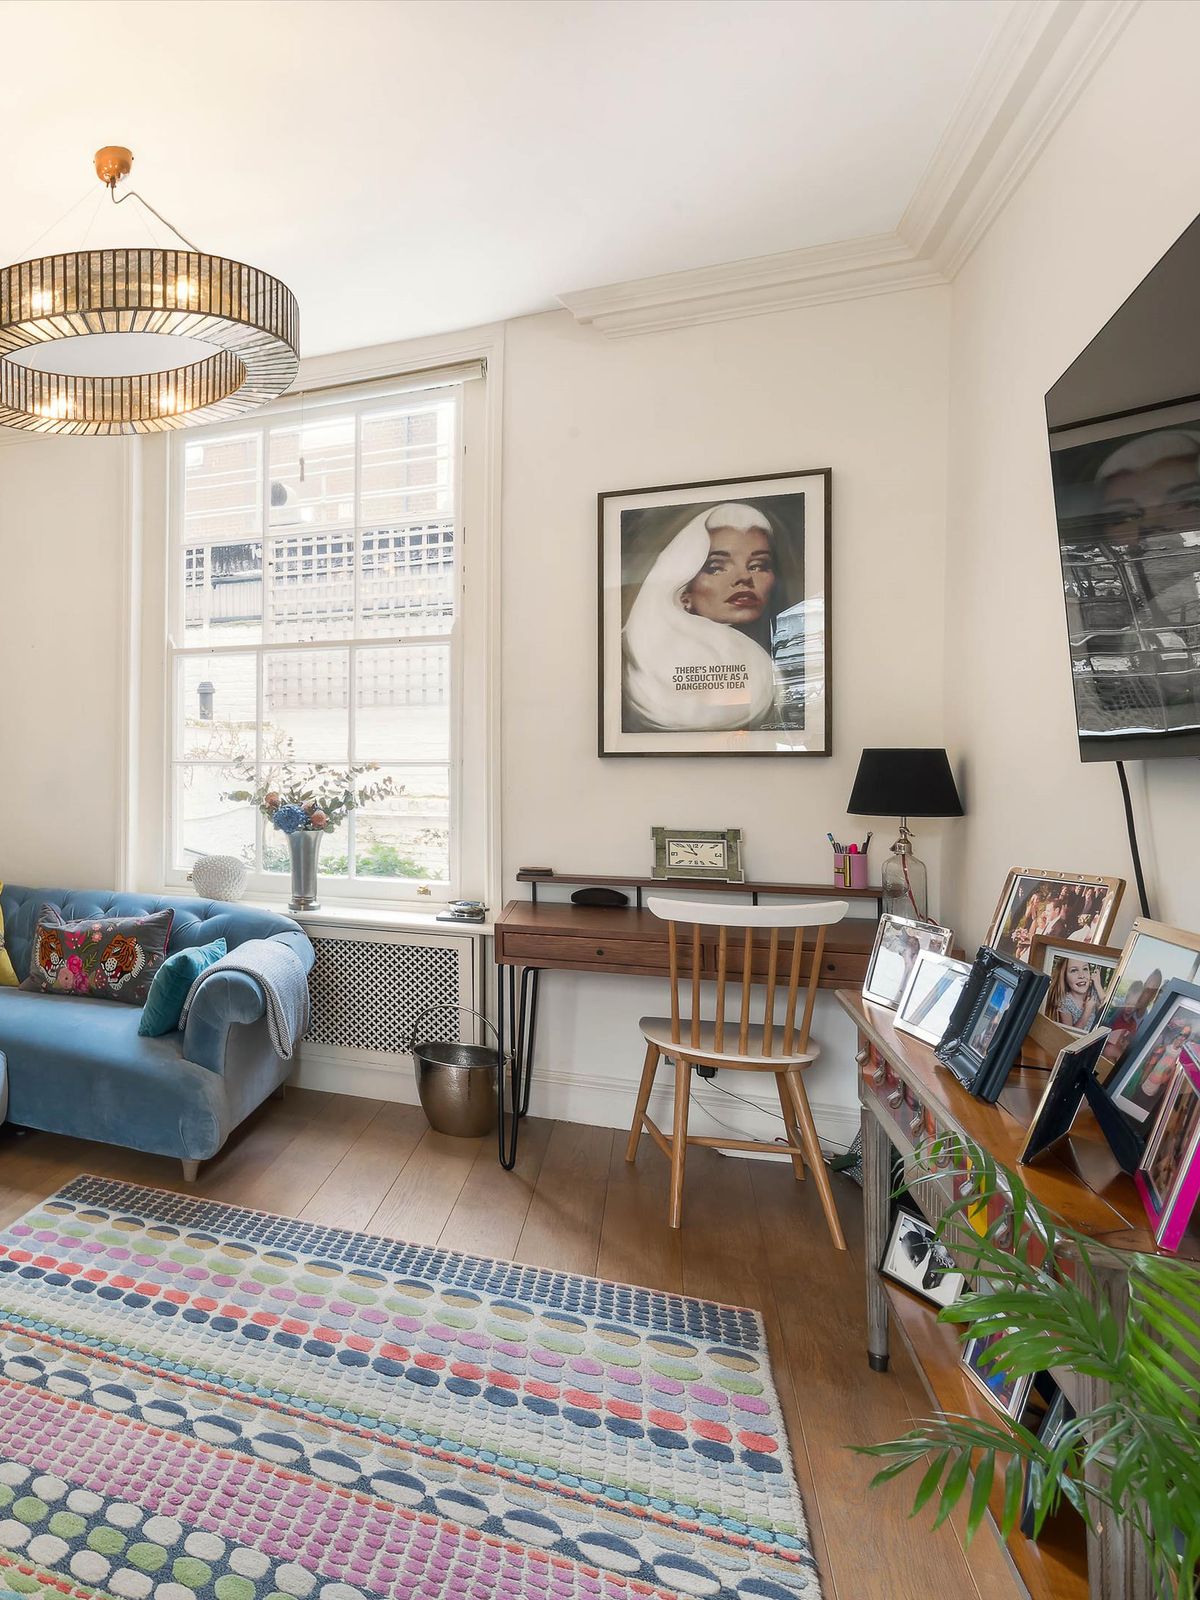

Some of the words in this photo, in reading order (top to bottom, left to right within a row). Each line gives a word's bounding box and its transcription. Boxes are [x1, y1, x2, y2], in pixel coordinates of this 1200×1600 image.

[675, 666, 707, 674] THERE'S
[709, 664, 746, 673] NOTHING
[685, 674, 728, 682] SEDUCTIVE
[730, 673, 740, 681] AS
[743, 672, 749, 680] A
[676, 682, 724, 690] DANGEROUS
[727, 681, 745, 689] IDEA
